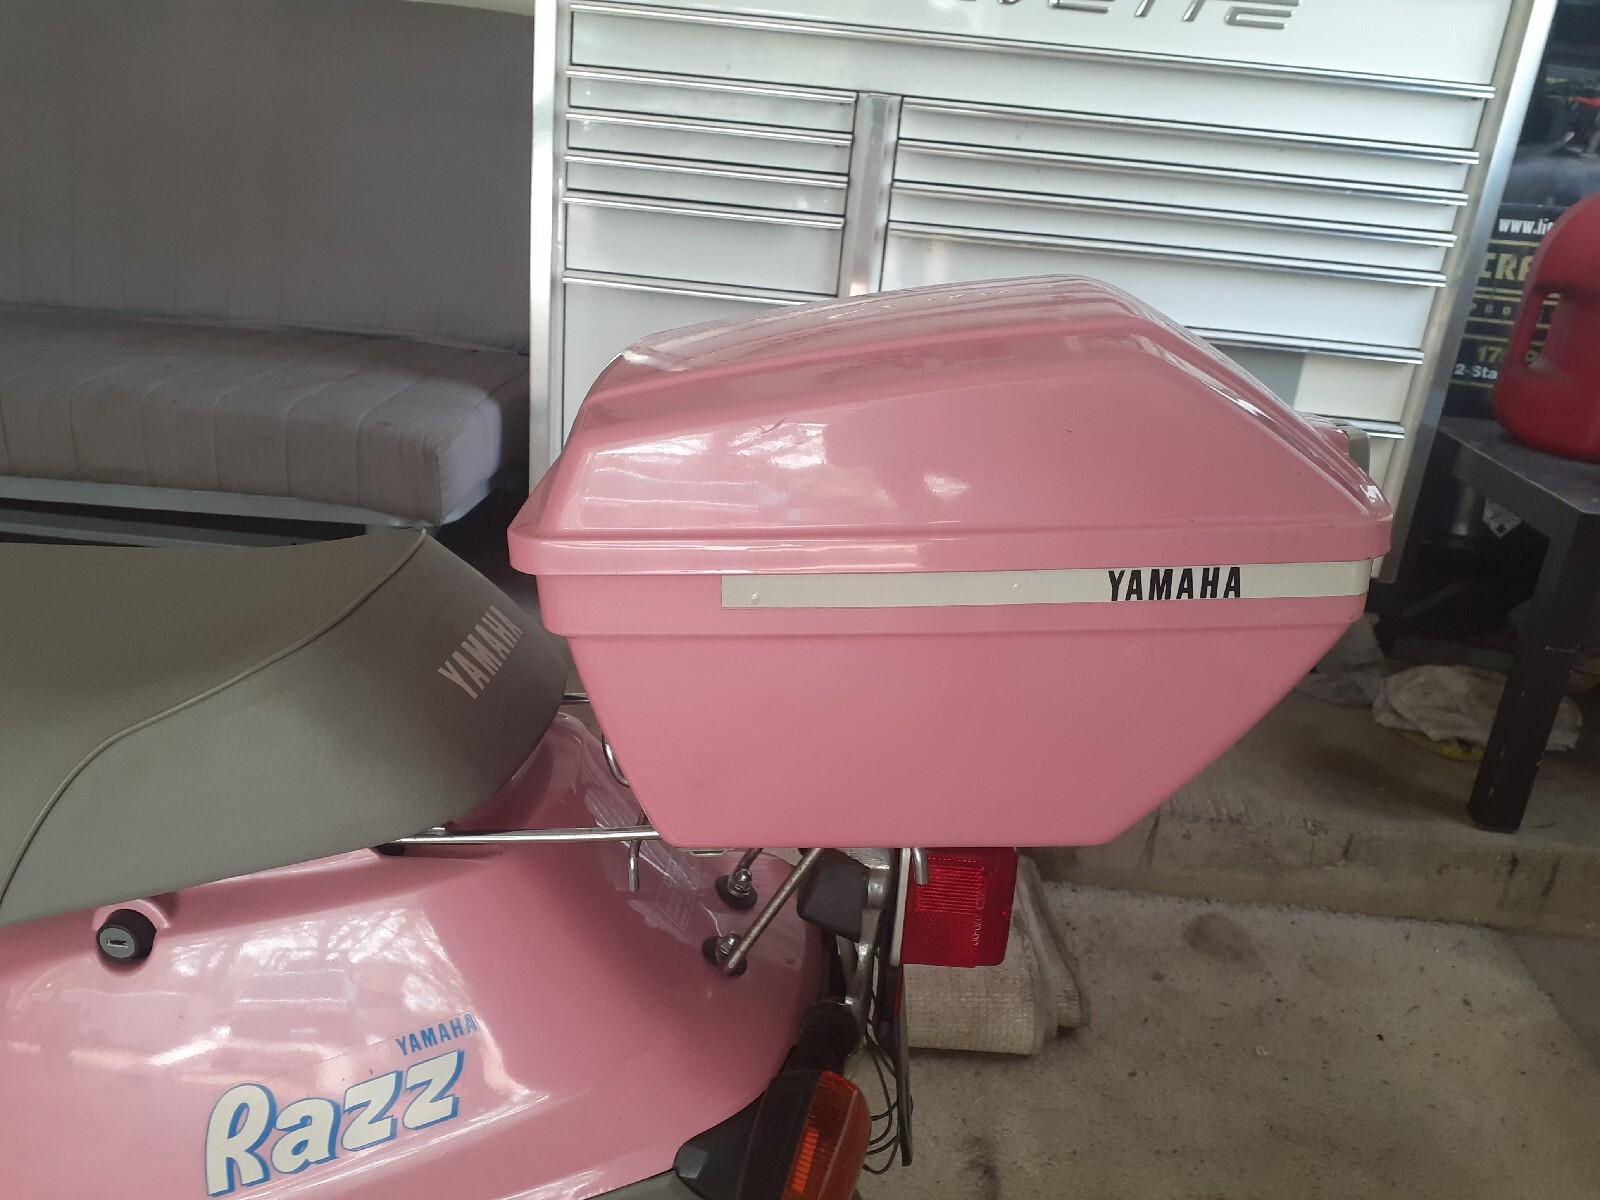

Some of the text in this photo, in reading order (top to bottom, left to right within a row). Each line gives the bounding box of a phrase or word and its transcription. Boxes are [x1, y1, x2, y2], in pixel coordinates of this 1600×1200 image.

[1478, 345, 1504, 363] 17
[1108, 566, 1241, 602] YAMAHA
[438, 604, 523, 700] YAMAHA
[395, 1012, 478, 1057] YAMAHA
[205, 1049, 465, 1198] Razz
